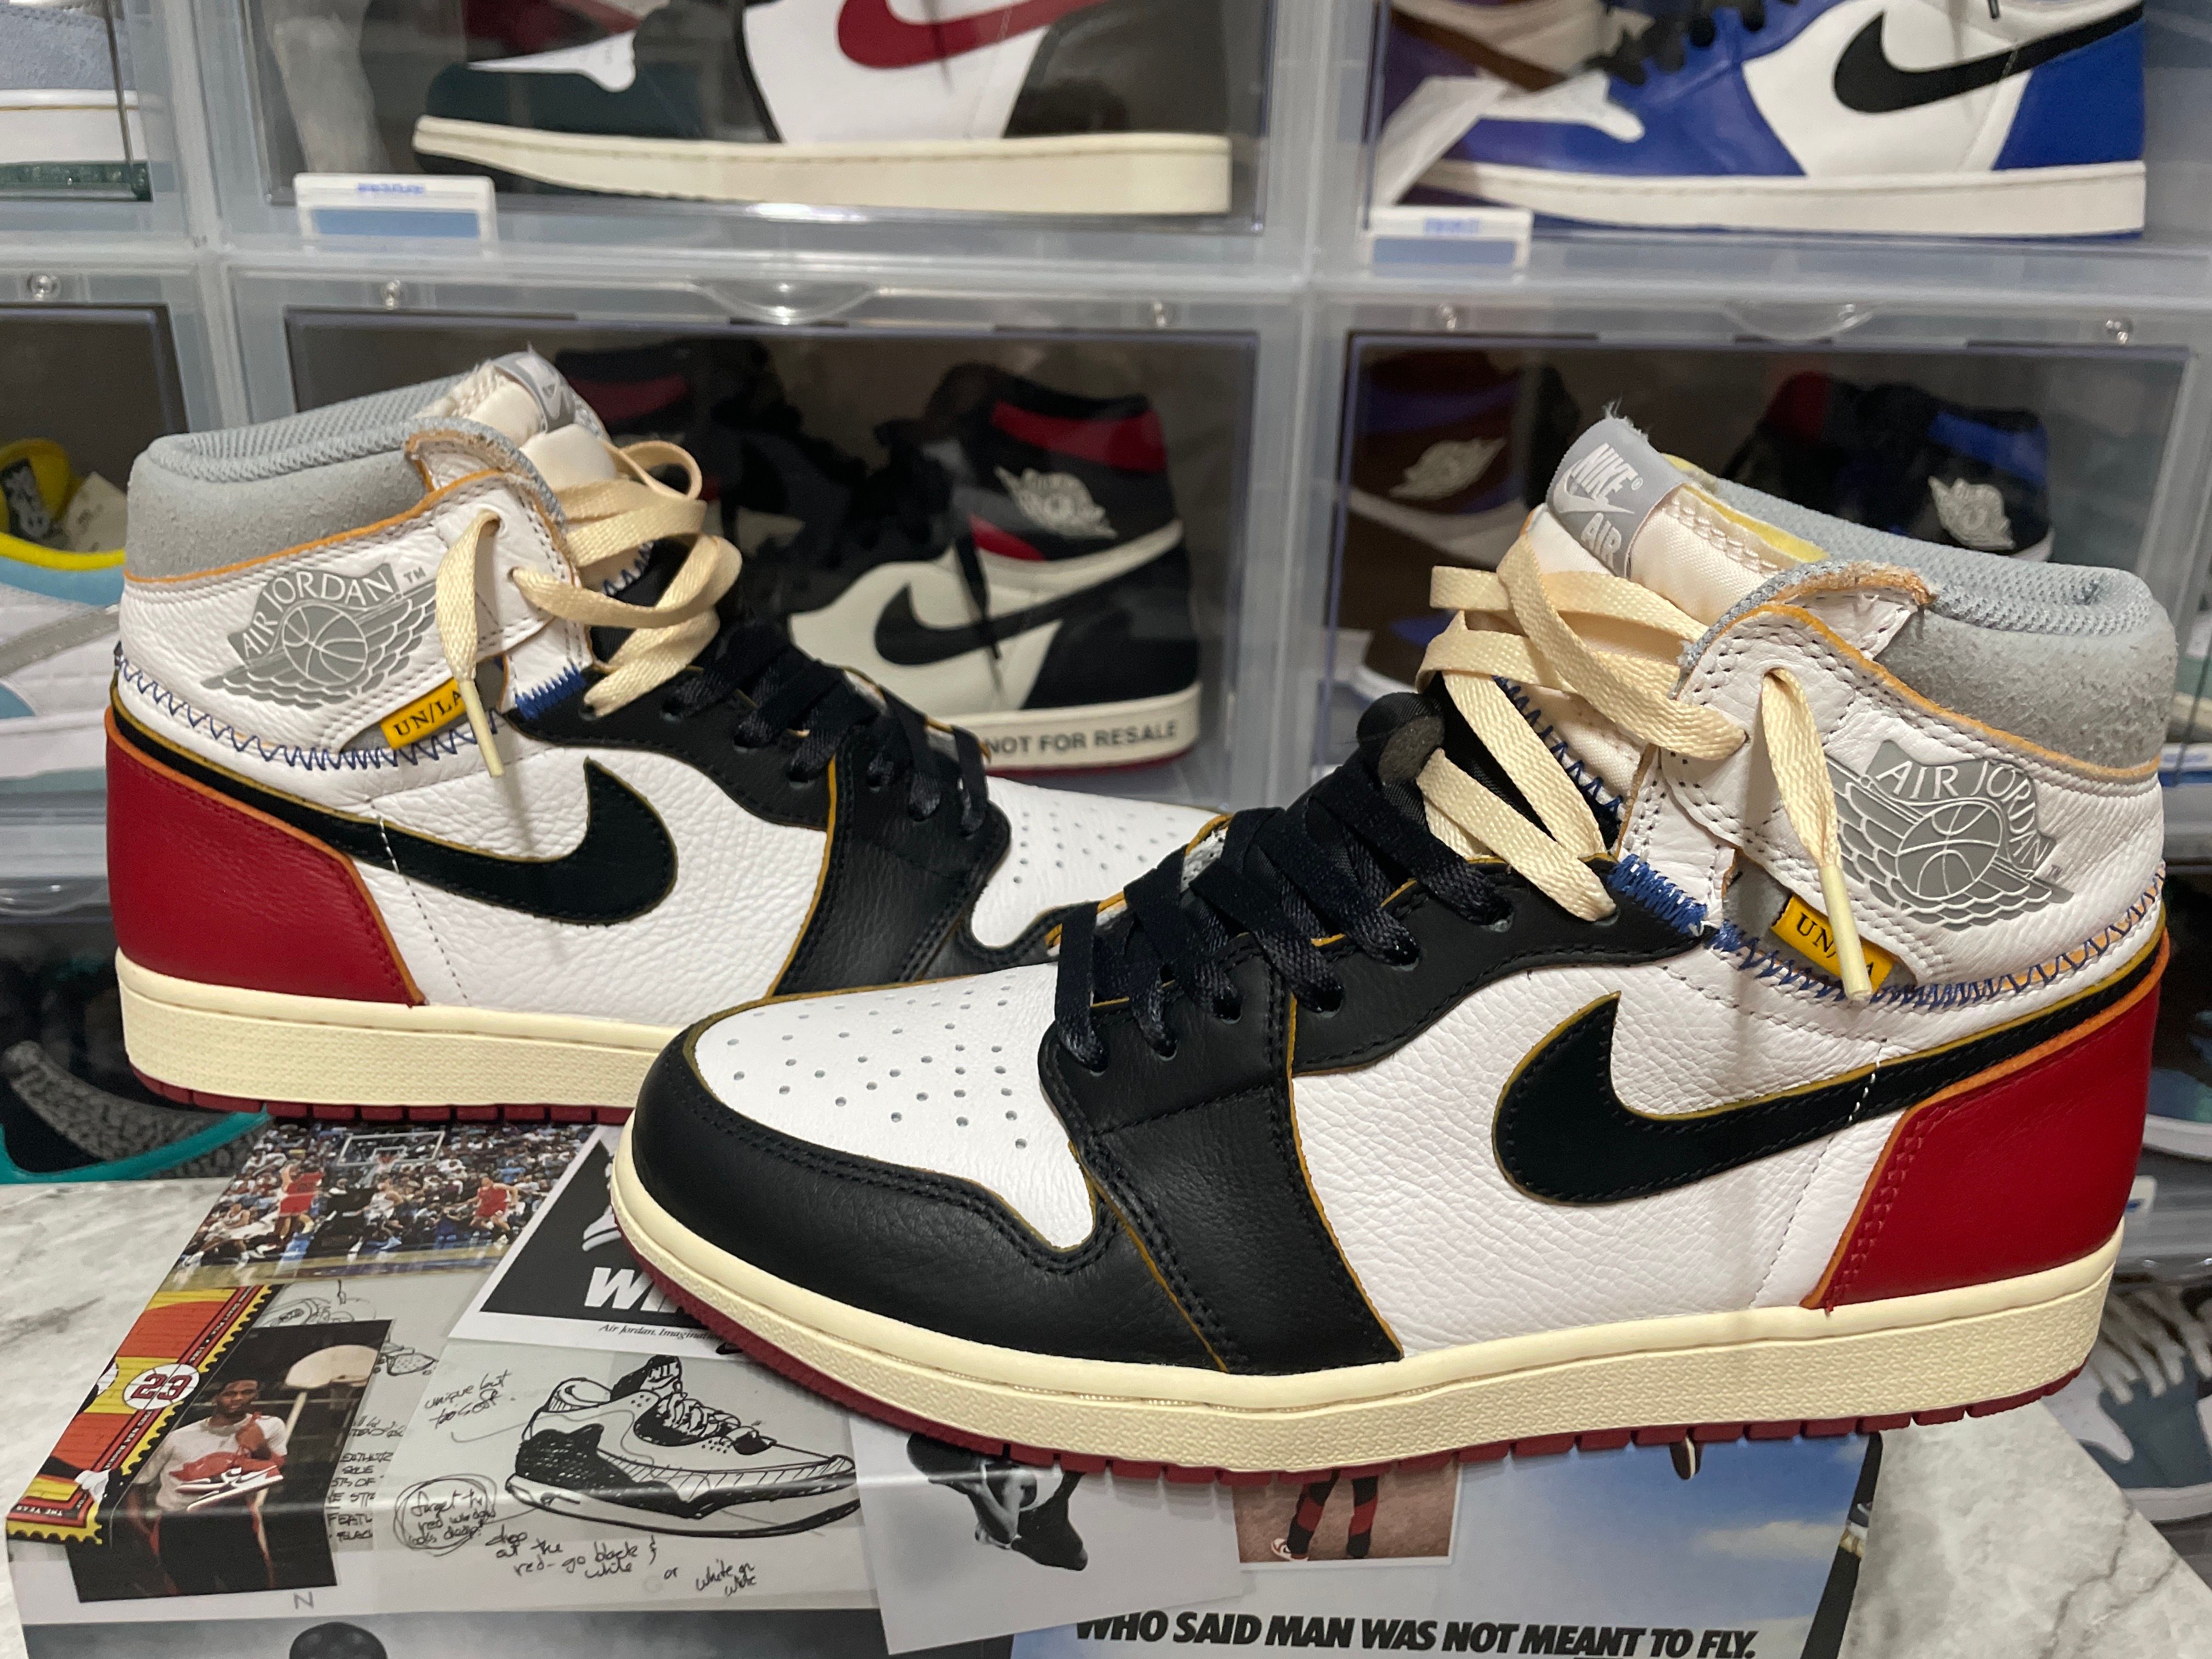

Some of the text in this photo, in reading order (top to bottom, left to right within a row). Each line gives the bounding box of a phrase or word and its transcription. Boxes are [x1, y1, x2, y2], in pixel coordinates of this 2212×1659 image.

[1571, 443, 1638, 500] NIKE
[1581, 512, 1622, 571] AIR
[242, 571, 394, 658] AIR JORDAN
[986, 720, 1176, 755] NOT FOR RESALE
[1876, 760, 2051, 869] AIR JORDAN
[599, 1324, 619, 1332] Air
[619, 1325, 657, 1336] Jordan.
[131, 1373, 192, 1401] 23
[1076, 1610, 1758, 1659] WHO SAID MAN WAS NOT MEANT TO FLY.
